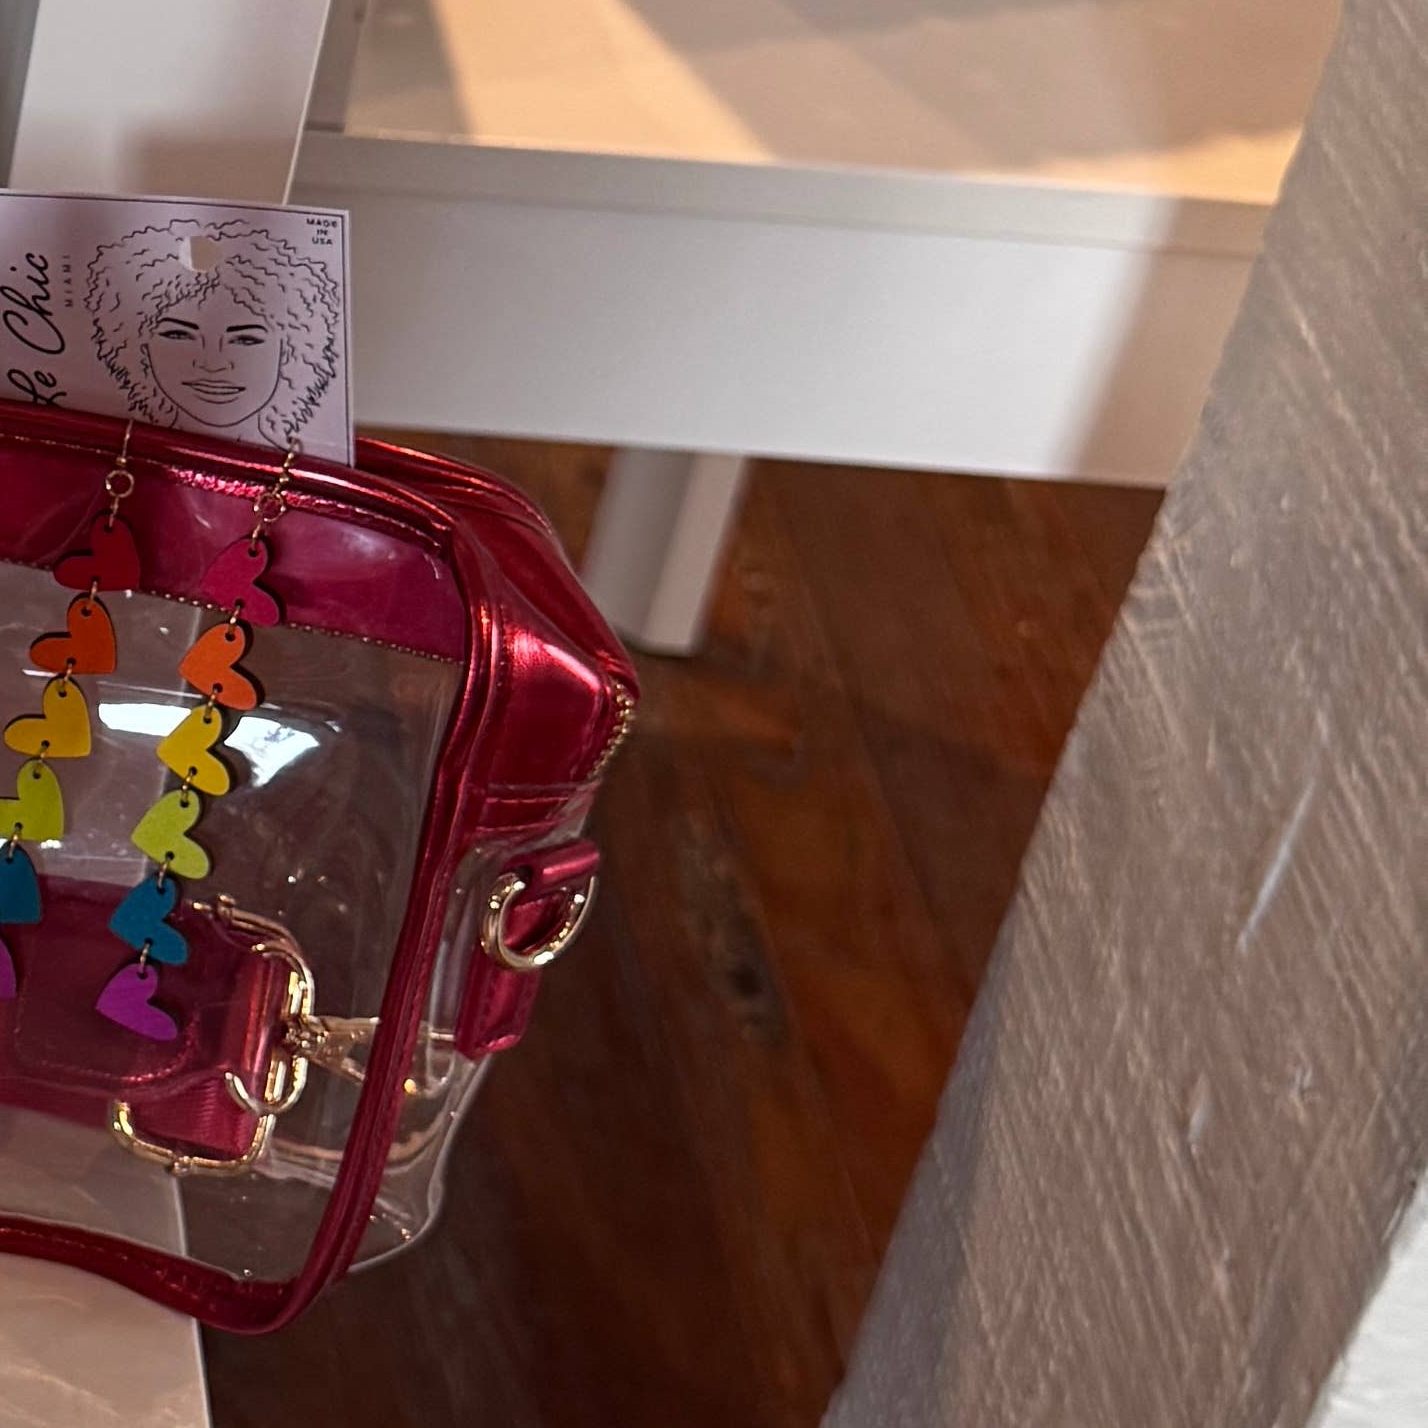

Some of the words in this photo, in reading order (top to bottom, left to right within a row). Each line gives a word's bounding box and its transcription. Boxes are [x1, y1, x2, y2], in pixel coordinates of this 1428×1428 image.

[305, 218, 338, 228] MADE
[311, 236, 334, 246] USA
[0, 252, 65, 356] Chic
